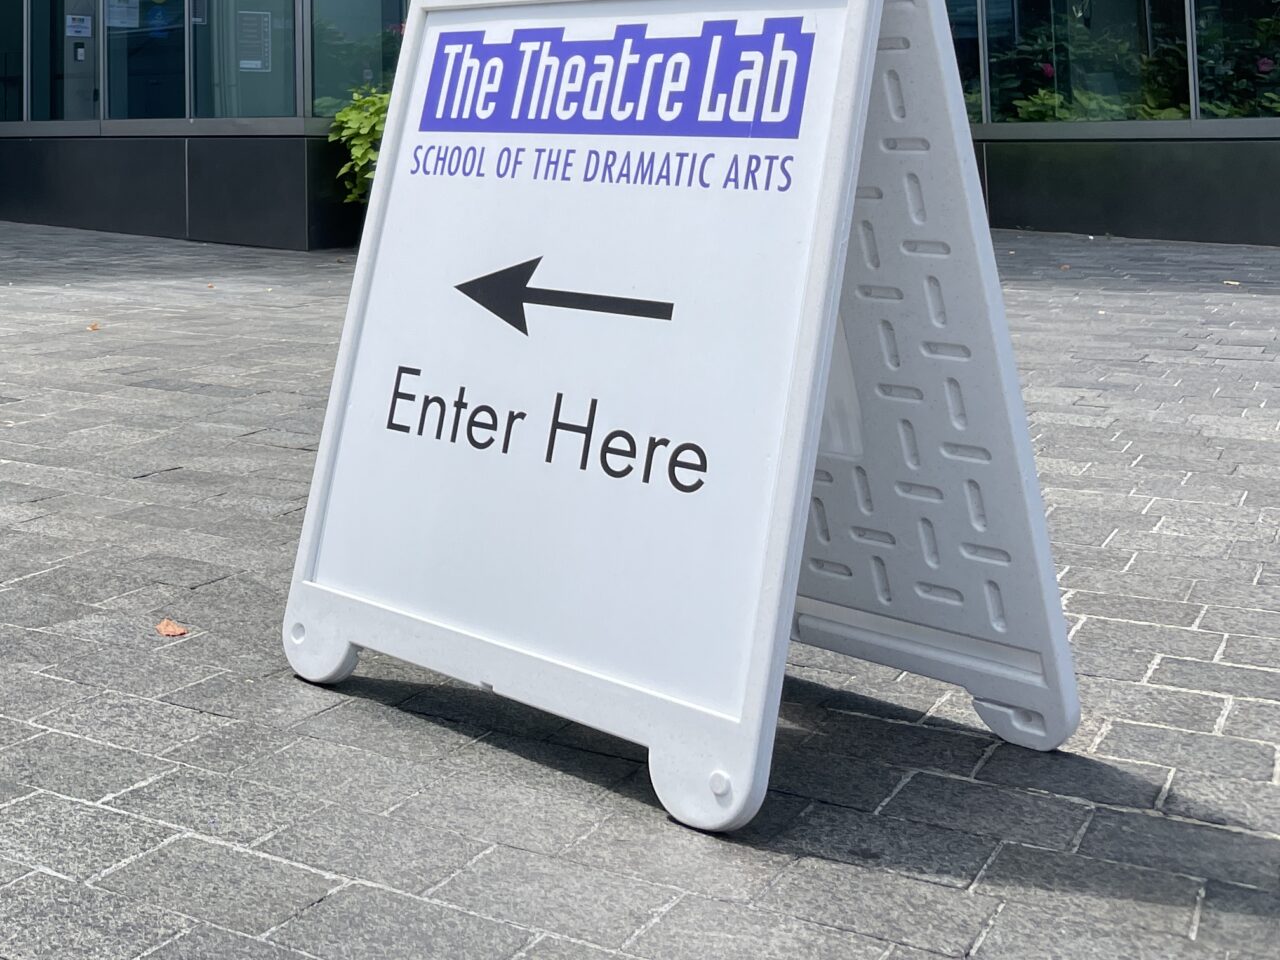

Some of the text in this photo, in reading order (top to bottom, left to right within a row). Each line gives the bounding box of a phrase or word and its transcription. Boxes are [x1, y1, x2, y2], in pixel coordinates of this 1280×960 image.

[435, 32, 797, 123] The Theatre Lab
[410, 145, 794, 193] SCHOOL OF THE DRAMATIC ARTS
[386, 365, 708, 493] Enter Here
